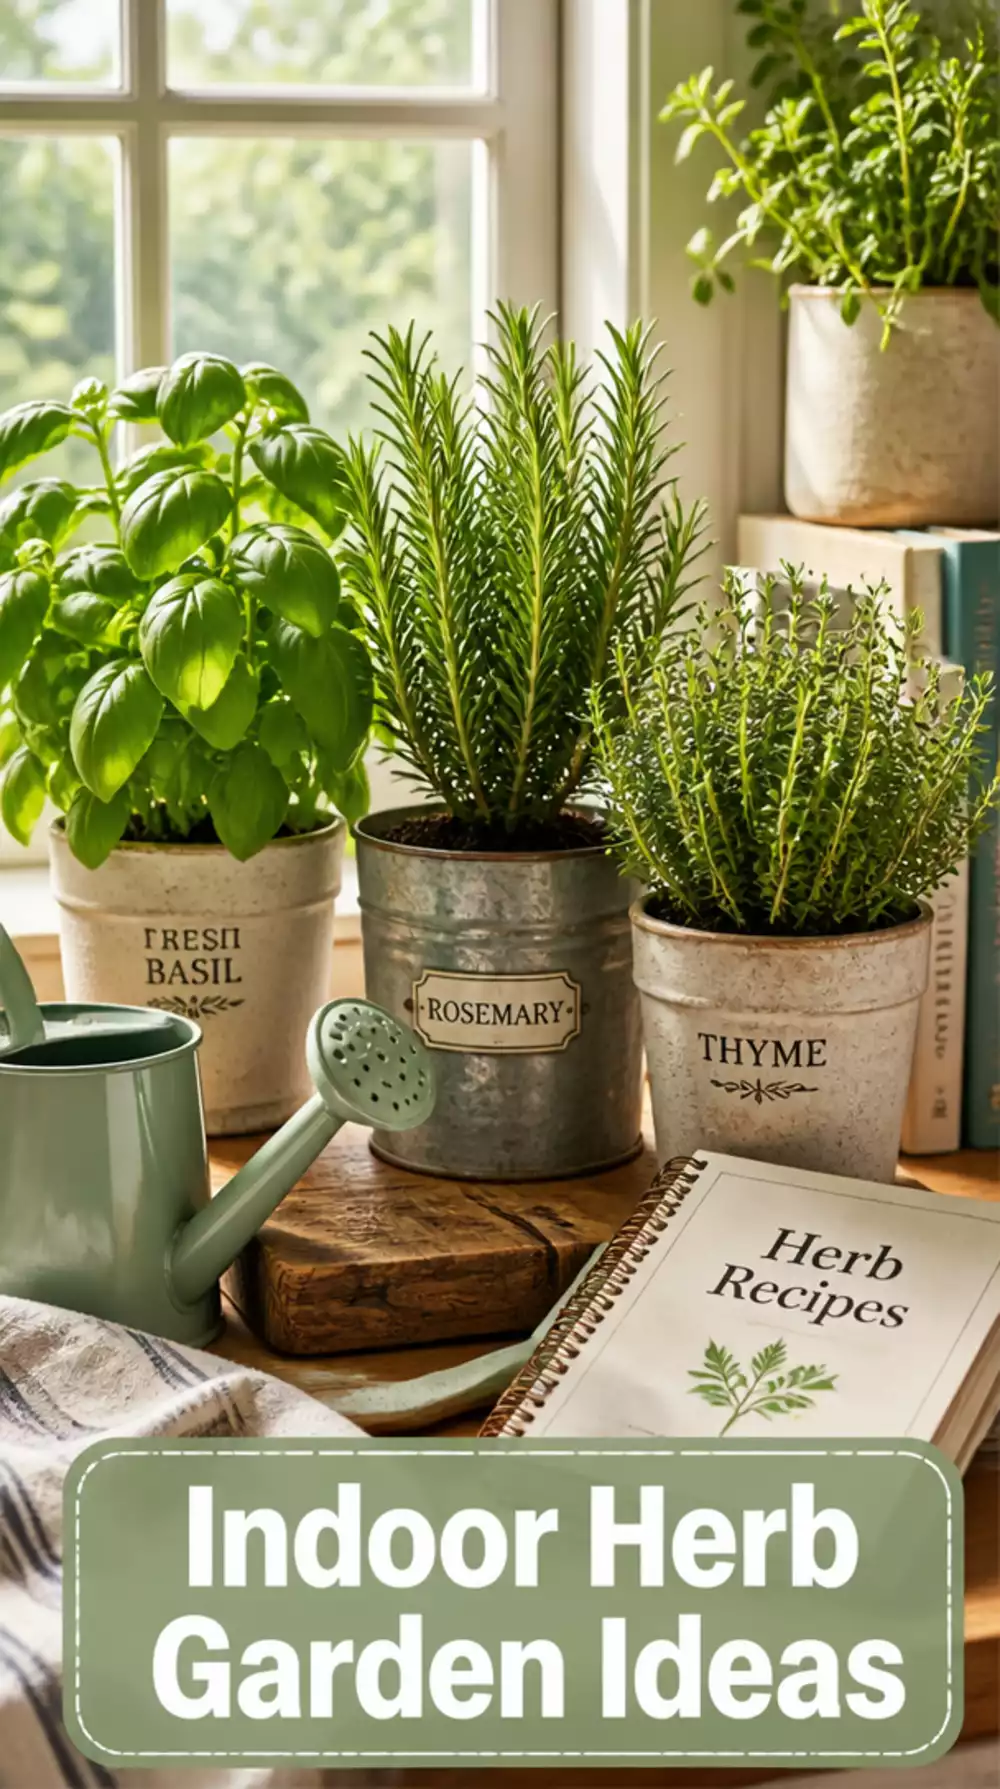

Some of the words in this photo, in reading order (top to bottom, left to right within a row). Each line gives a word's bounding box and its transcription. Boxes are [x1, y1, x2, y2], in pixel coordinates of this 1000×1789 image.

[145, 957, 243, 986] BASIL
[427, 997, 565, 1026] ROSEMARY
[697, 1031, 828, 1068] THYME
[760, 1227, 904, 1282] Herb
[706, 1262, 910, 1329] Recipes
